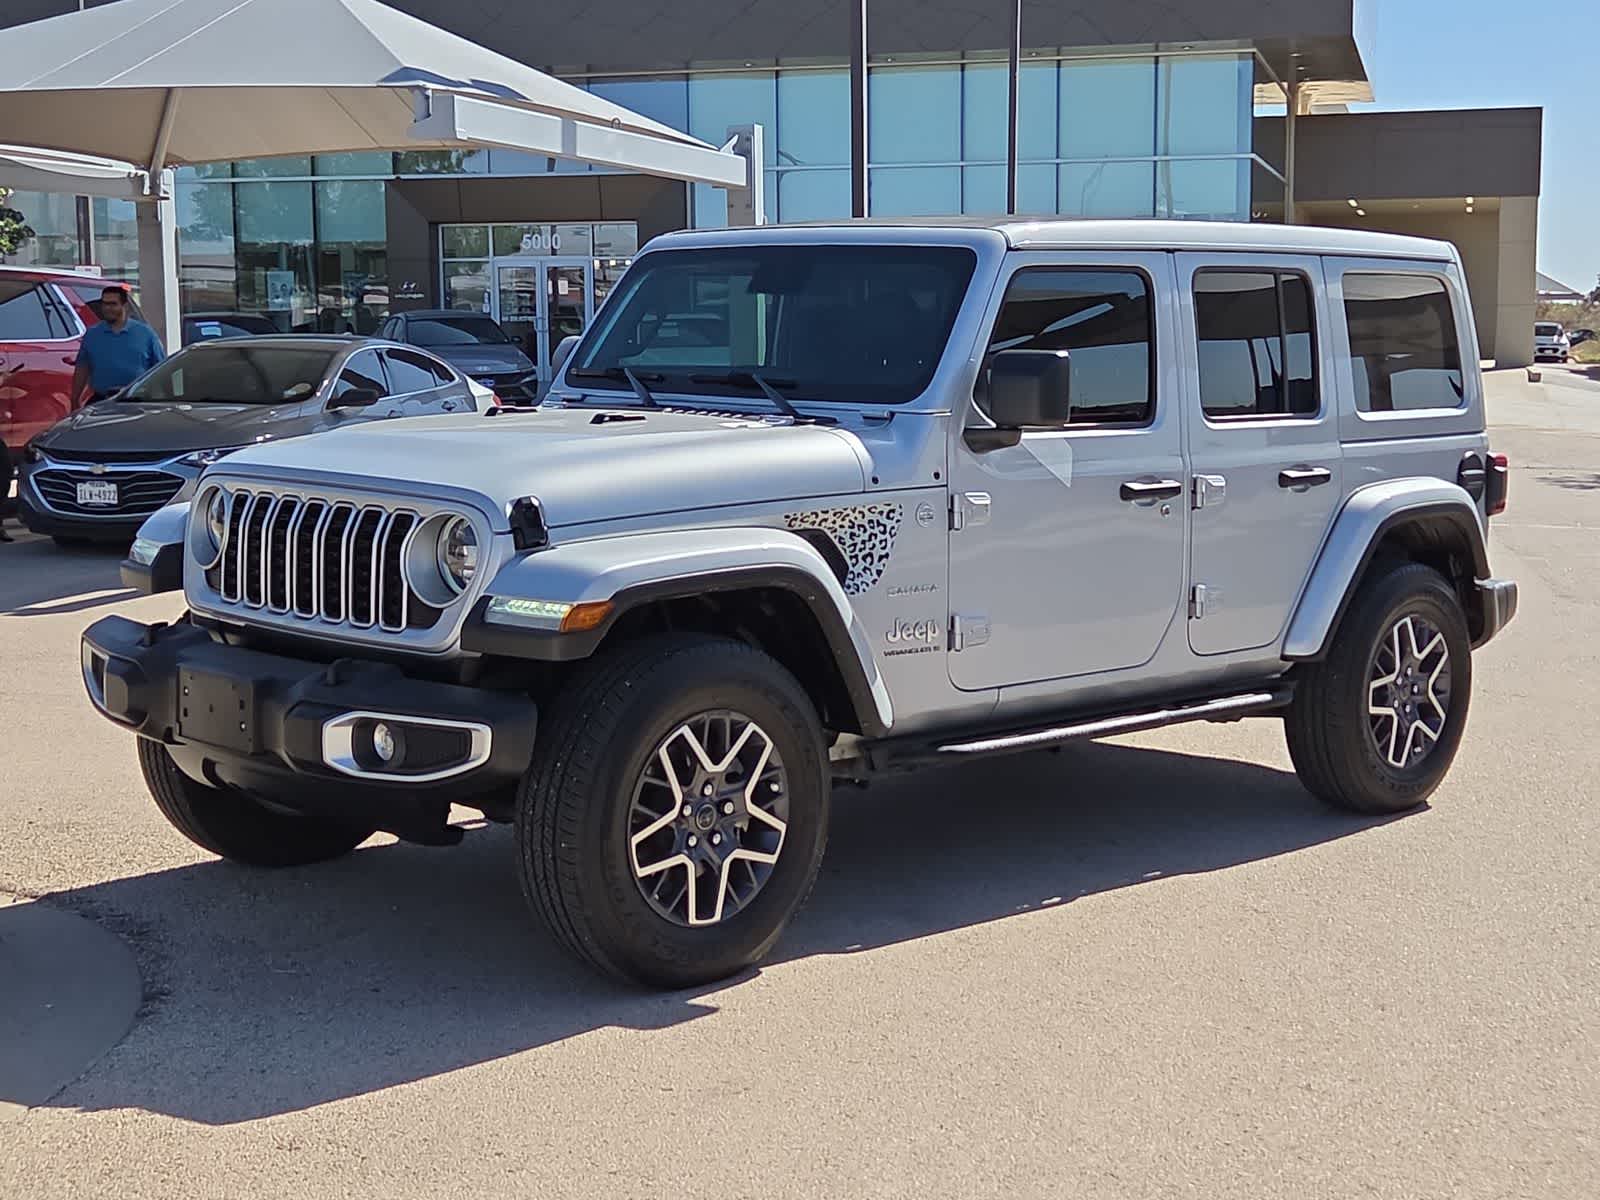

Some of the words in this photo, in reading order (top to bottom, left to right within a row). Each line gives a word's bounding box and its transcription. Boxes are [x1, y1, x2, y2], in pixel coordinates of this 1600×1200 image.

[521, 233, 561, 250] 5000
[885, 617, 938, 643] Jeep
[883, 646, 932, 657] WRANGLER
